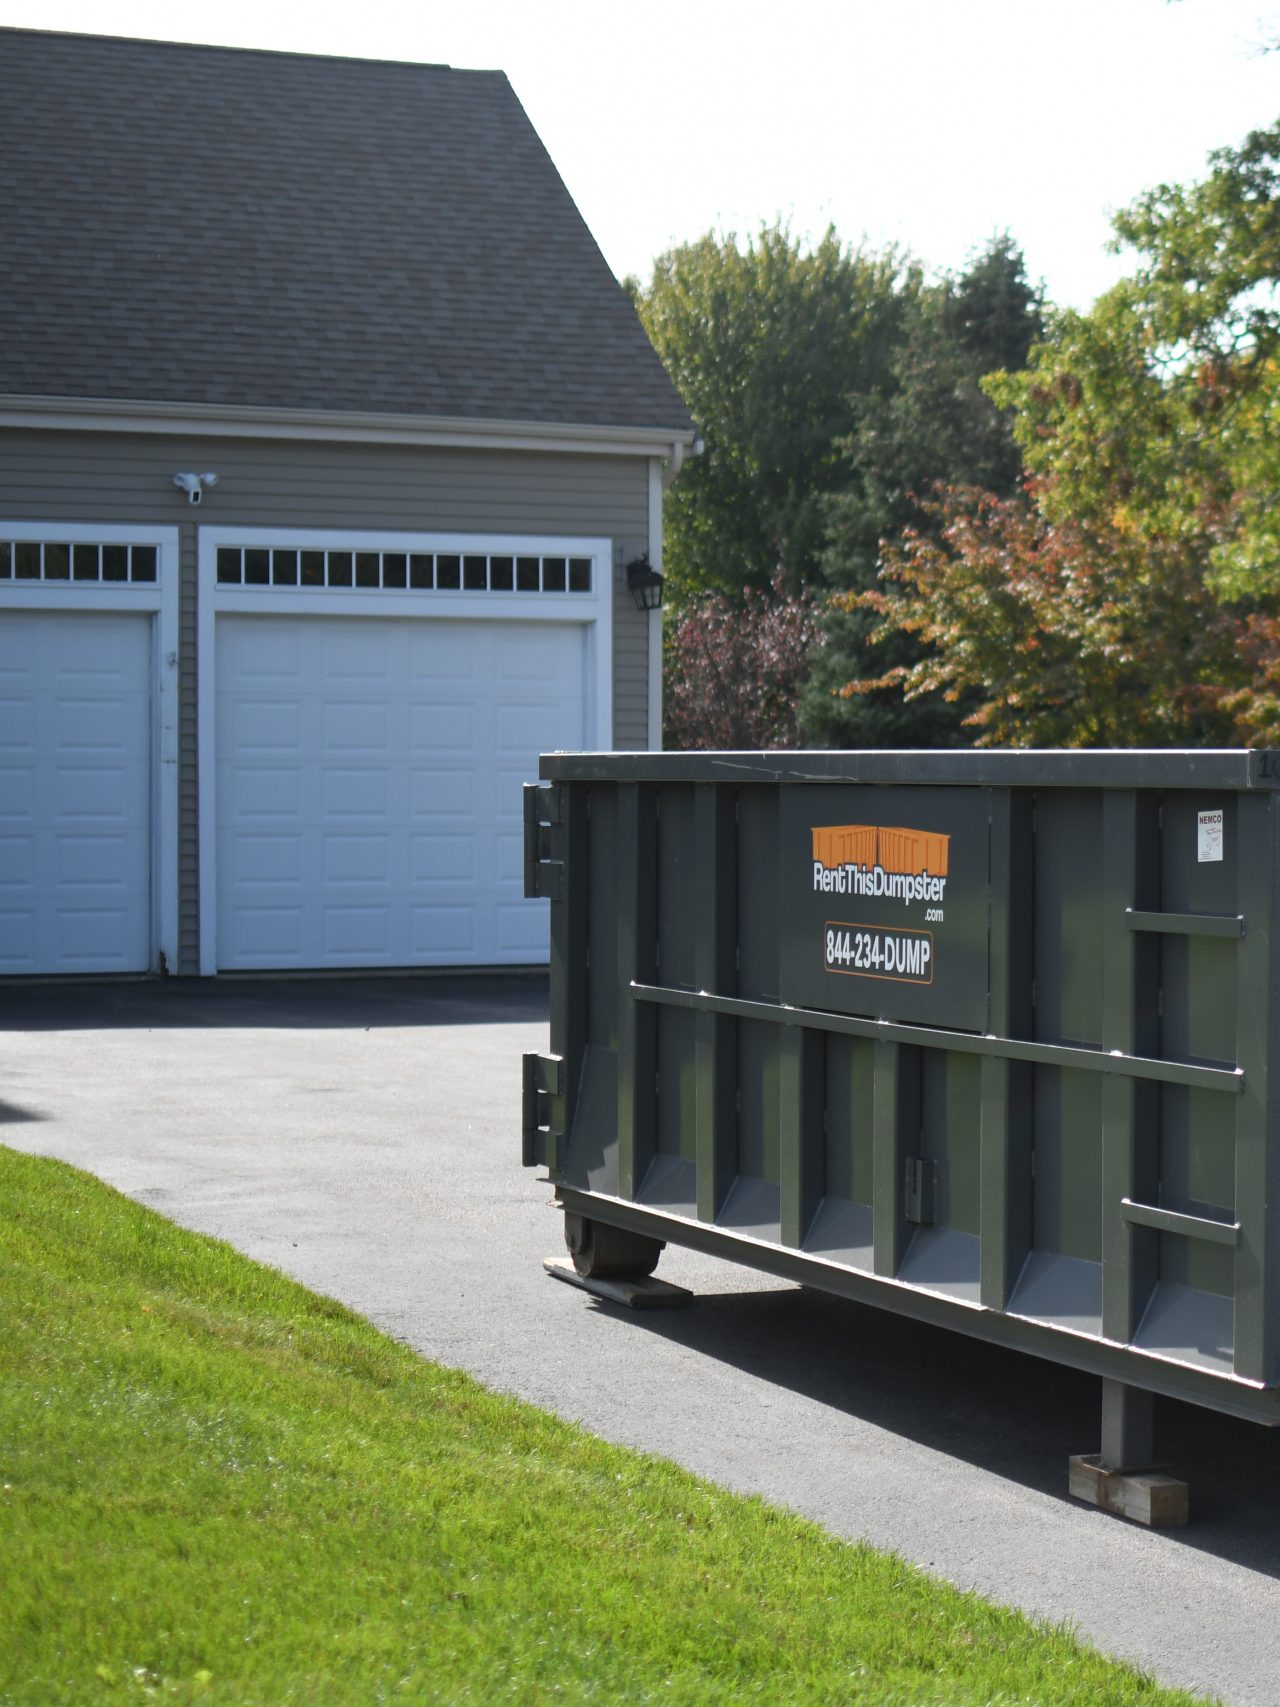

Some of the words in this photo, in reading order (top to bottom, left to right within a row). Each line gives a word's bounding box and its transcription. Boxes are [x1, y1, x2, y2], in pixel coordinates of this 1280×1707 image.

[1200, 814, 1222, 825] NEMCO
[814, 862, 946, 906] RentThisDumpster
[925, 908, 944, 923] .com
[826, 929, 931, 976] 844-234-DUMP
